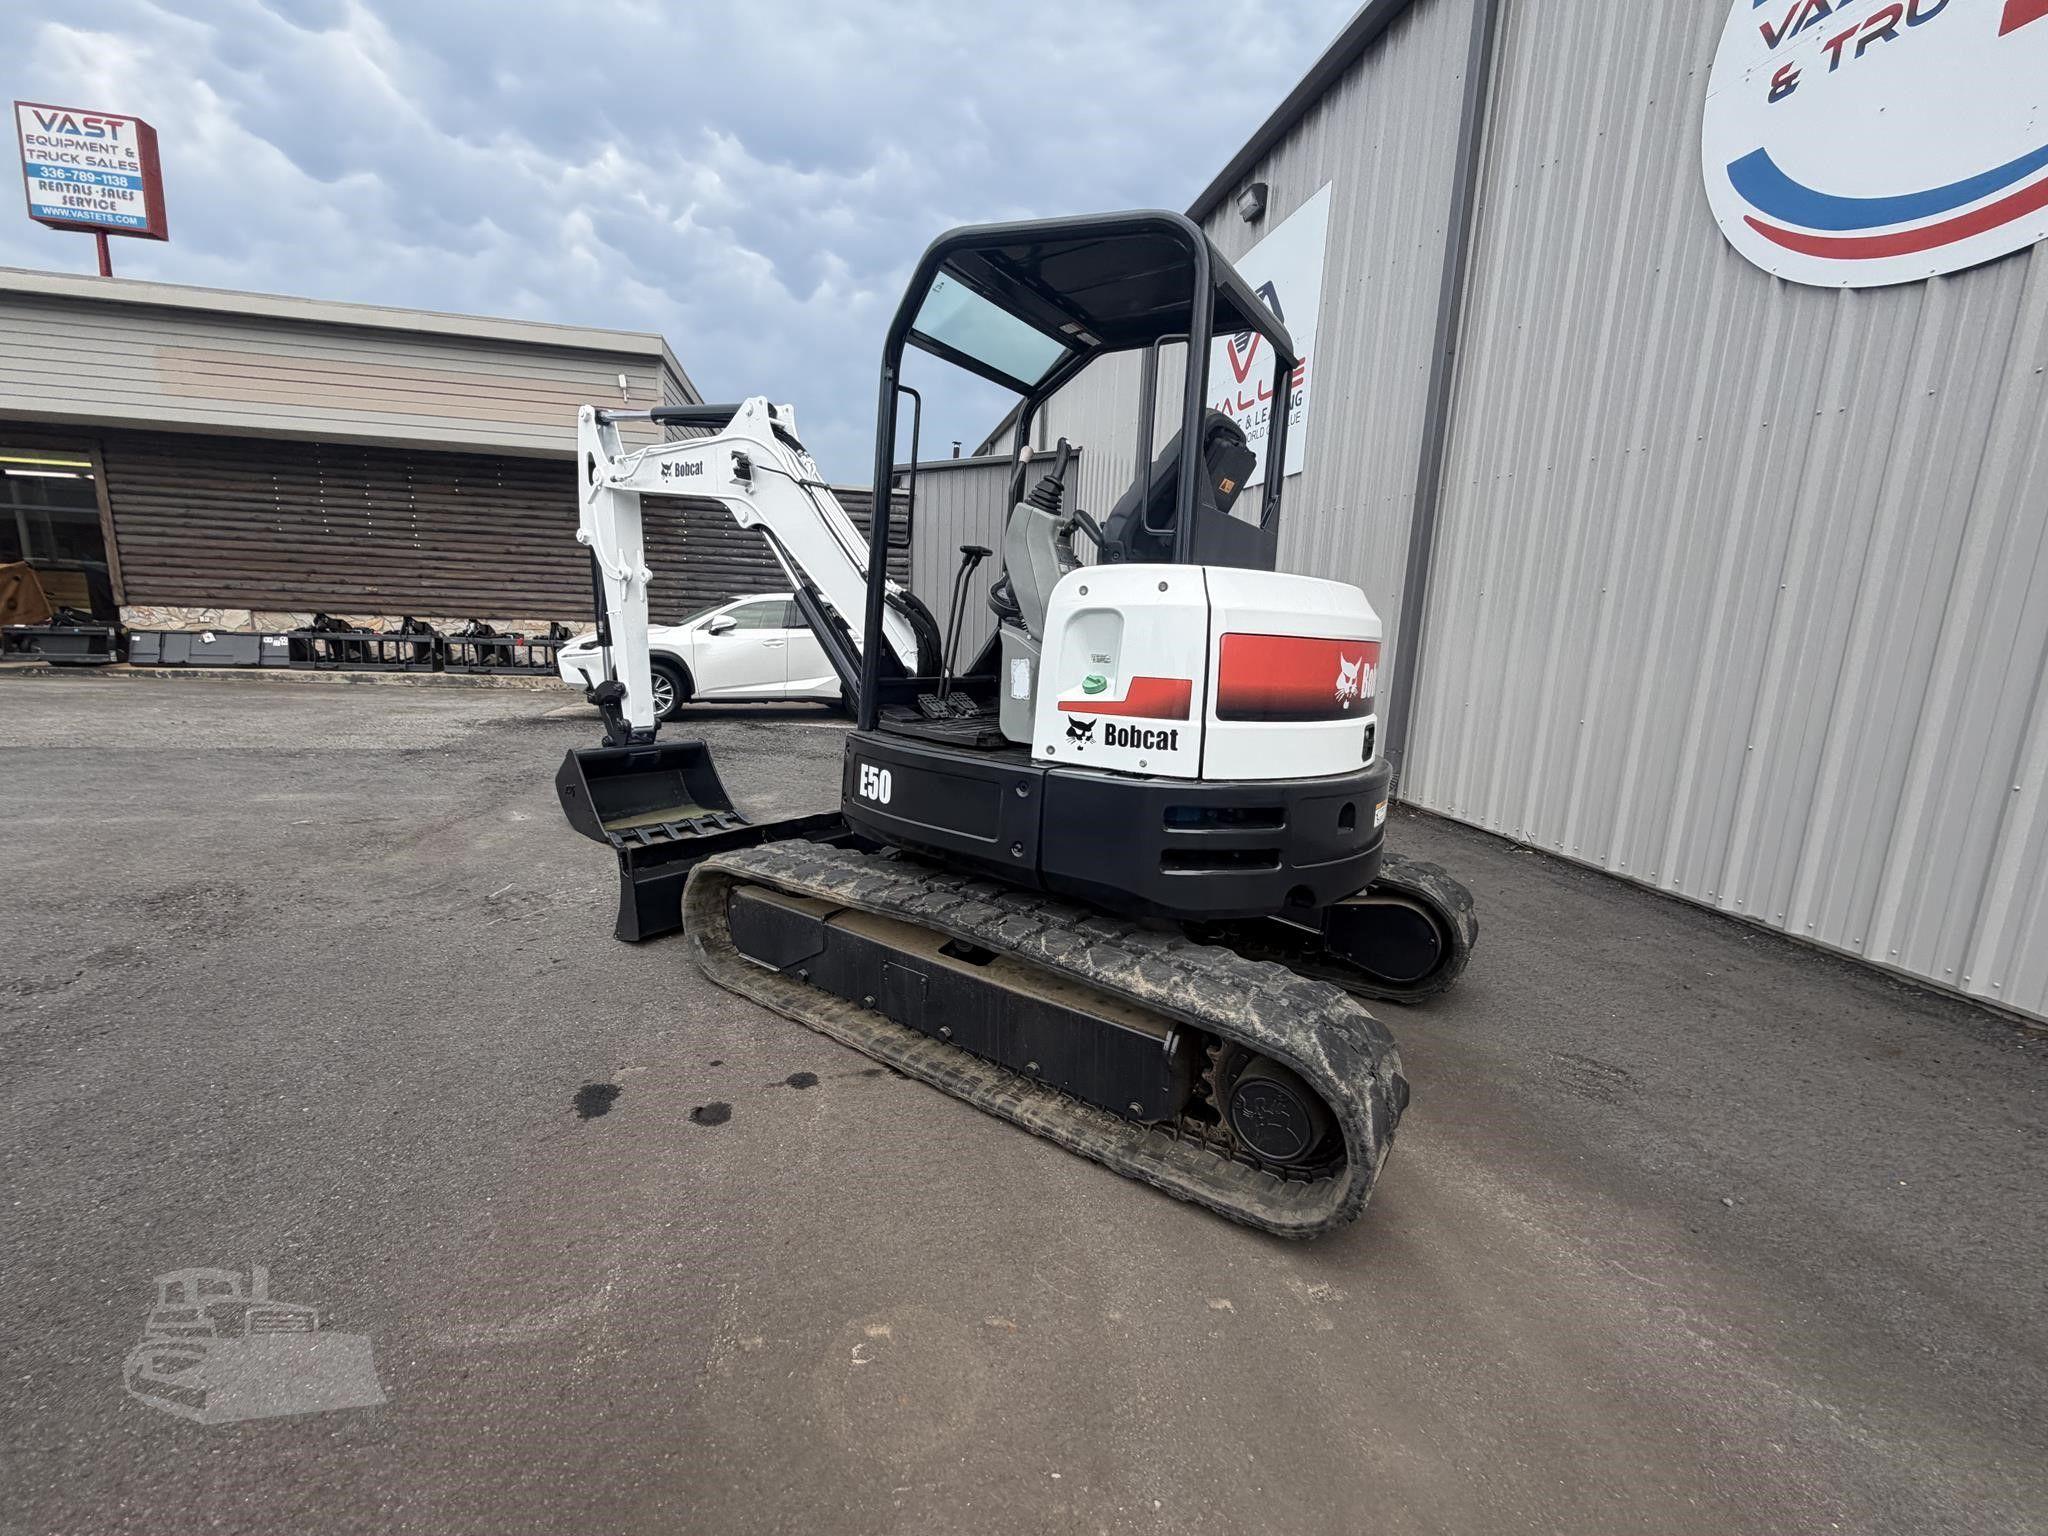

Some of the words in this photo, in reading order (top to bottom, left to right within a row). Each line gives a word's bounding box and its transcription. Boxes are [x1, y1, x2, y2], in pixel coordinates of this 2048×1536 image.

[1767, 60, 1803, 104] &
[32, 109, 125, 141] VAST
[25, 134, 119, 155] EQUIPMENT
[125, 147, 135, 158] &
[26, 148, 80, 165] TRUCK
[85, 155, 139, 173] SALES
[40, 166, 129, 187] 336-789-1138
[38, 180, 92, 196] RENTALS
[101, 189, 135, 201] SALES
[62, 195, 117, 211] SERVICE
[42, 206, 138, 225] WWW.VASTETS.COM
[675, 460, 703, 477] Bobcat
[1104, 723, 1179, 752] Bobcat
[859, 763, 892, 804] E50
